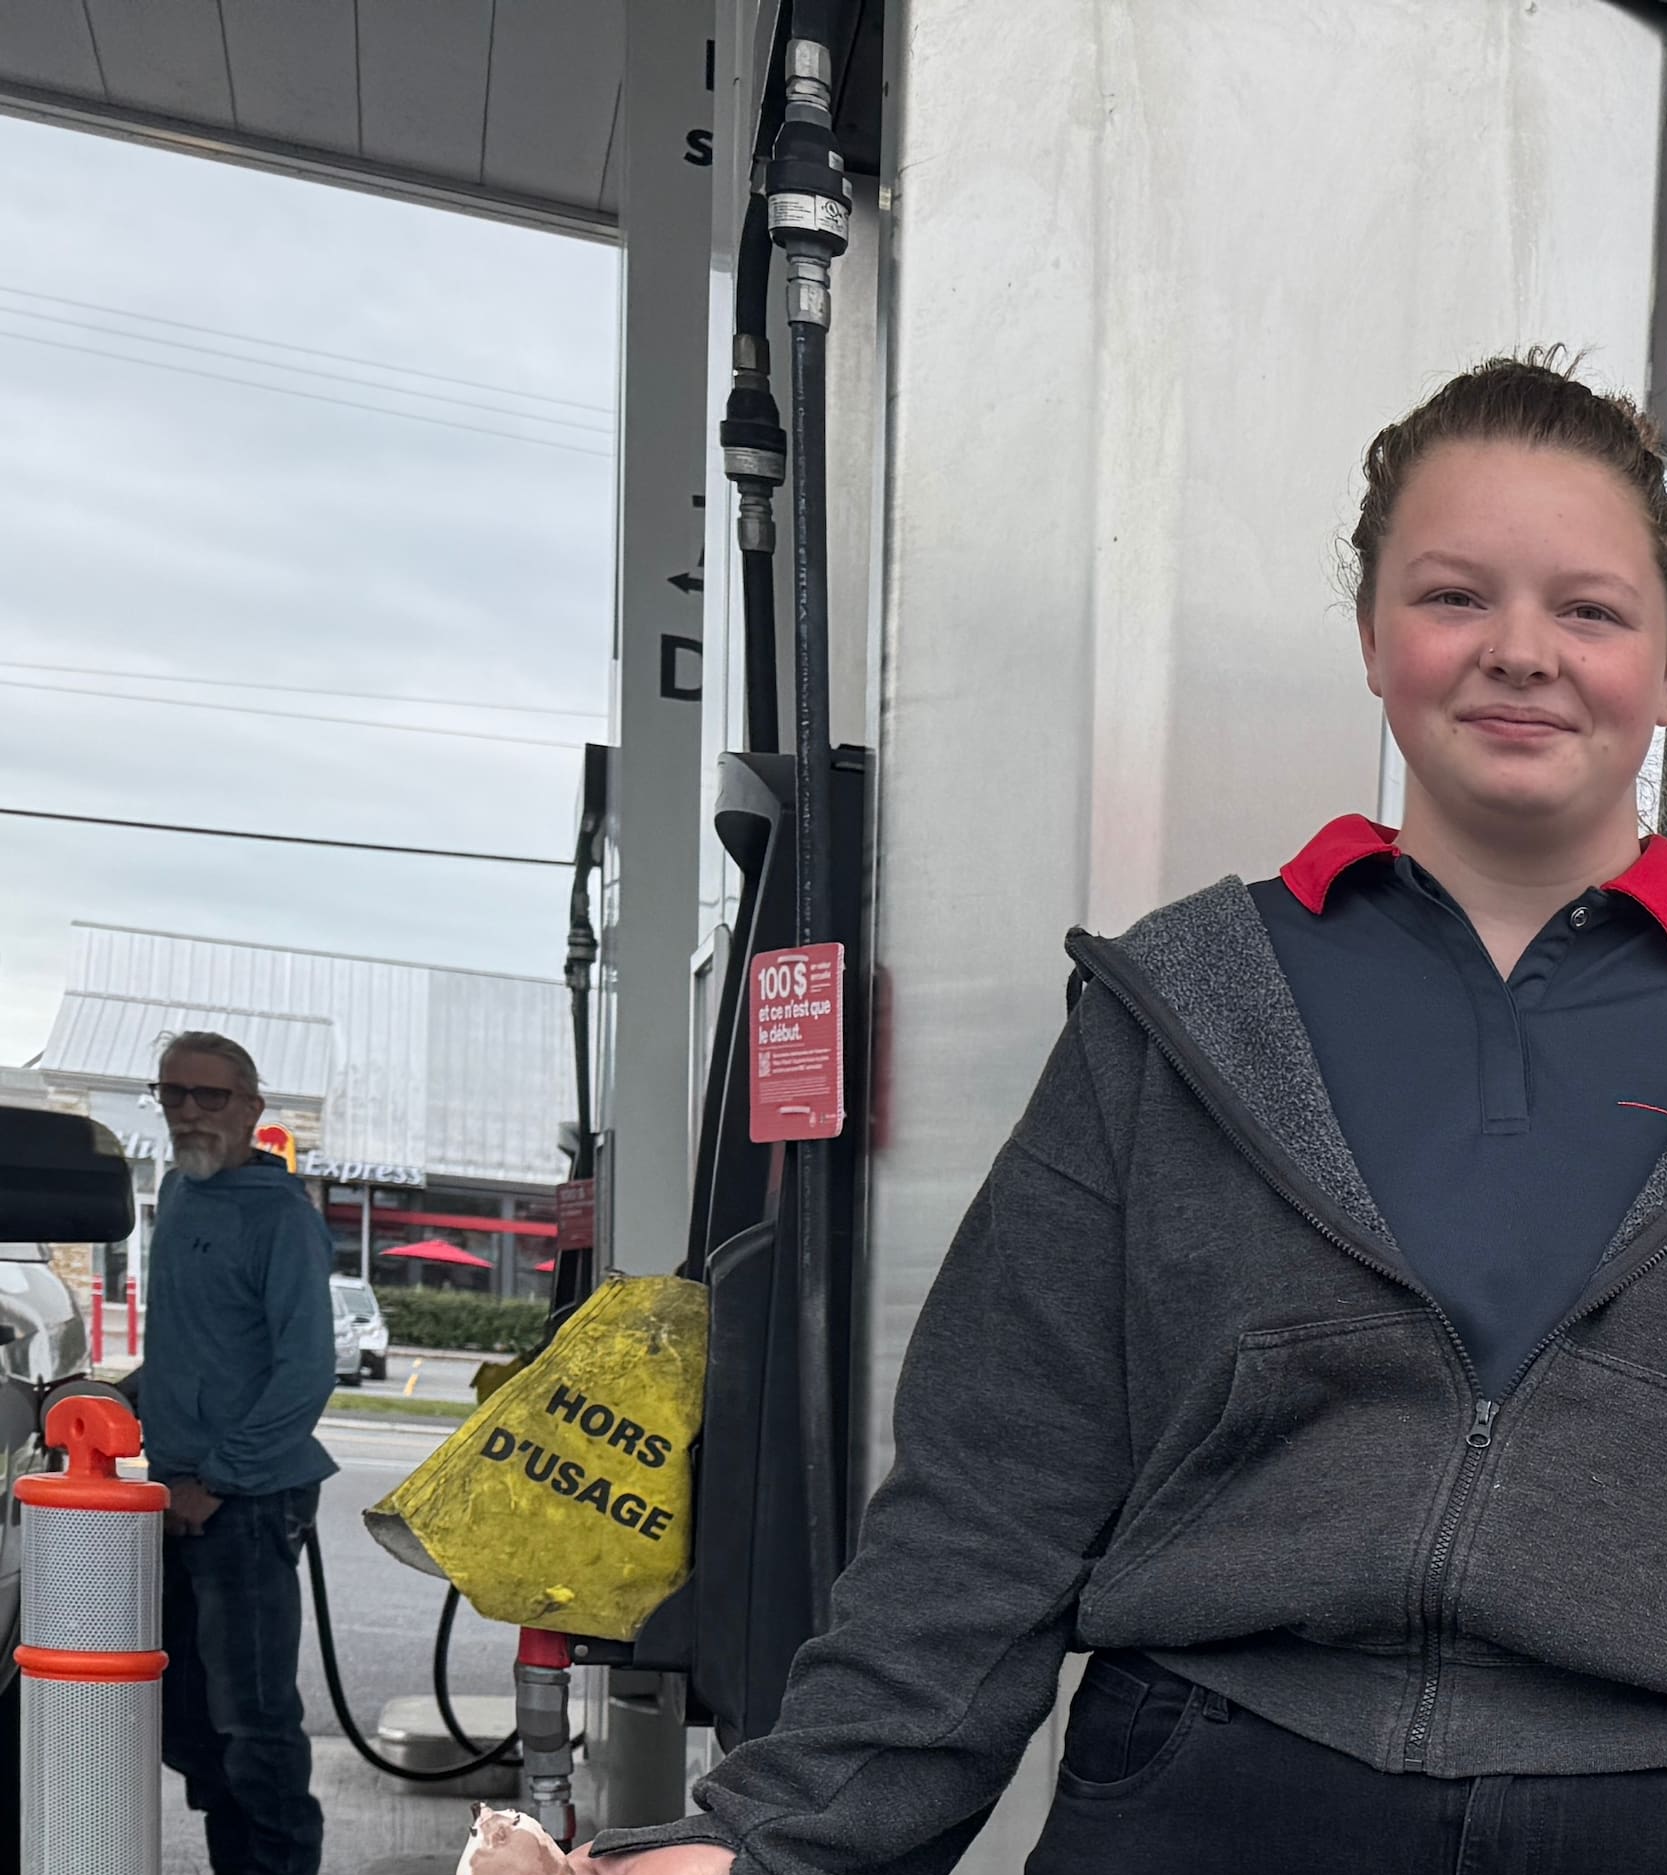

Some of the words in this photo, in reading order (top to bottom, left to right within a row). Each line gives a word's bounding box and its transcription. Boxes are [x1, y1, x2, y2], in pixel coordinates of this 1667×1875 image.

[758, 965, 791, 1000] 100
[793, 962, 808, 999] $
[758, 1004, 770, 1022] et
[770, 1003, 783, 1021] ce
[784, 999, 809, 1019] n'est
[810, 1000, 831, 1020] que
[758, 1026, 769, 1045] le
[303, 1149, 424, 1185] Express
[545, 1384, 673, 1469] HORS
[479, 1426, 675, 1542] D'USAGE
